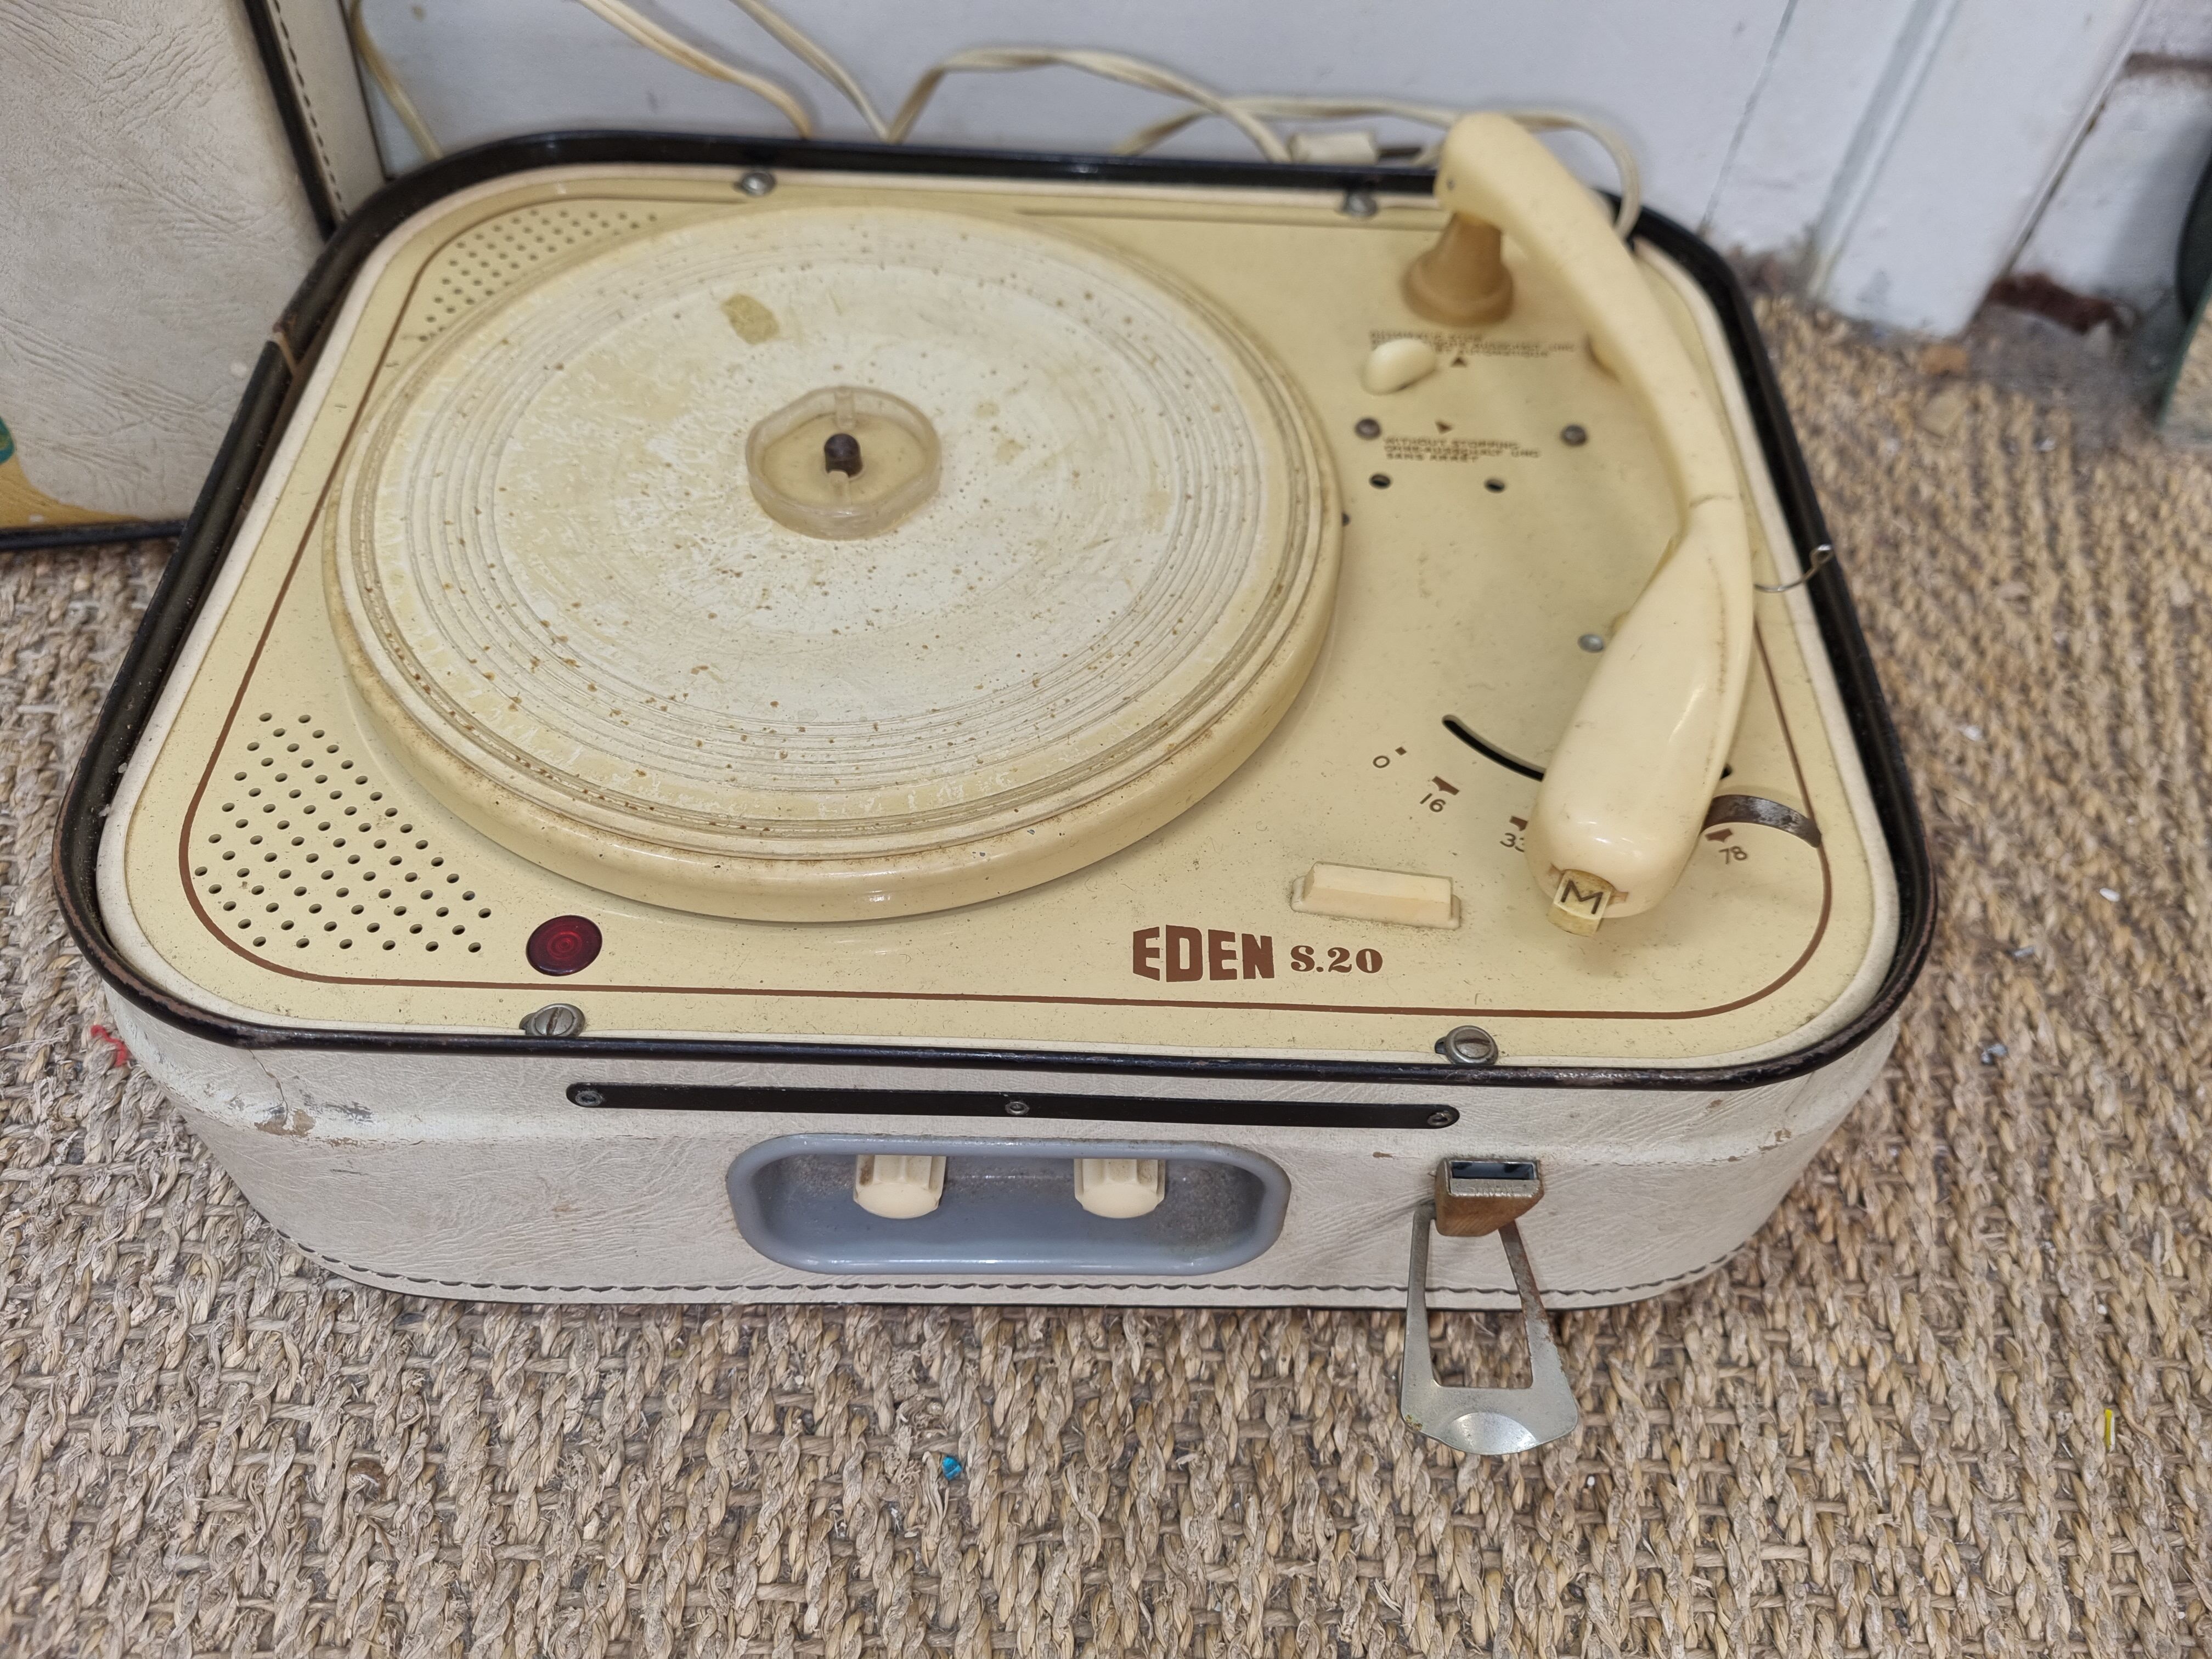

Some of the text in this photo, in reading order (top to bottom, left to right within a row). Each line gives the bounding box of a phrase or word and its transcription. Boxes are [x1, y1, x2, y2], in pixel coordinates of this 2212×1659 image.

[1419, 793, 1446, 812] 16
[1718, 845, 1747, 865] 78
[1560, 879, 1604, 915] M
[1133, 924, 1383, 983] EDEN S.20
